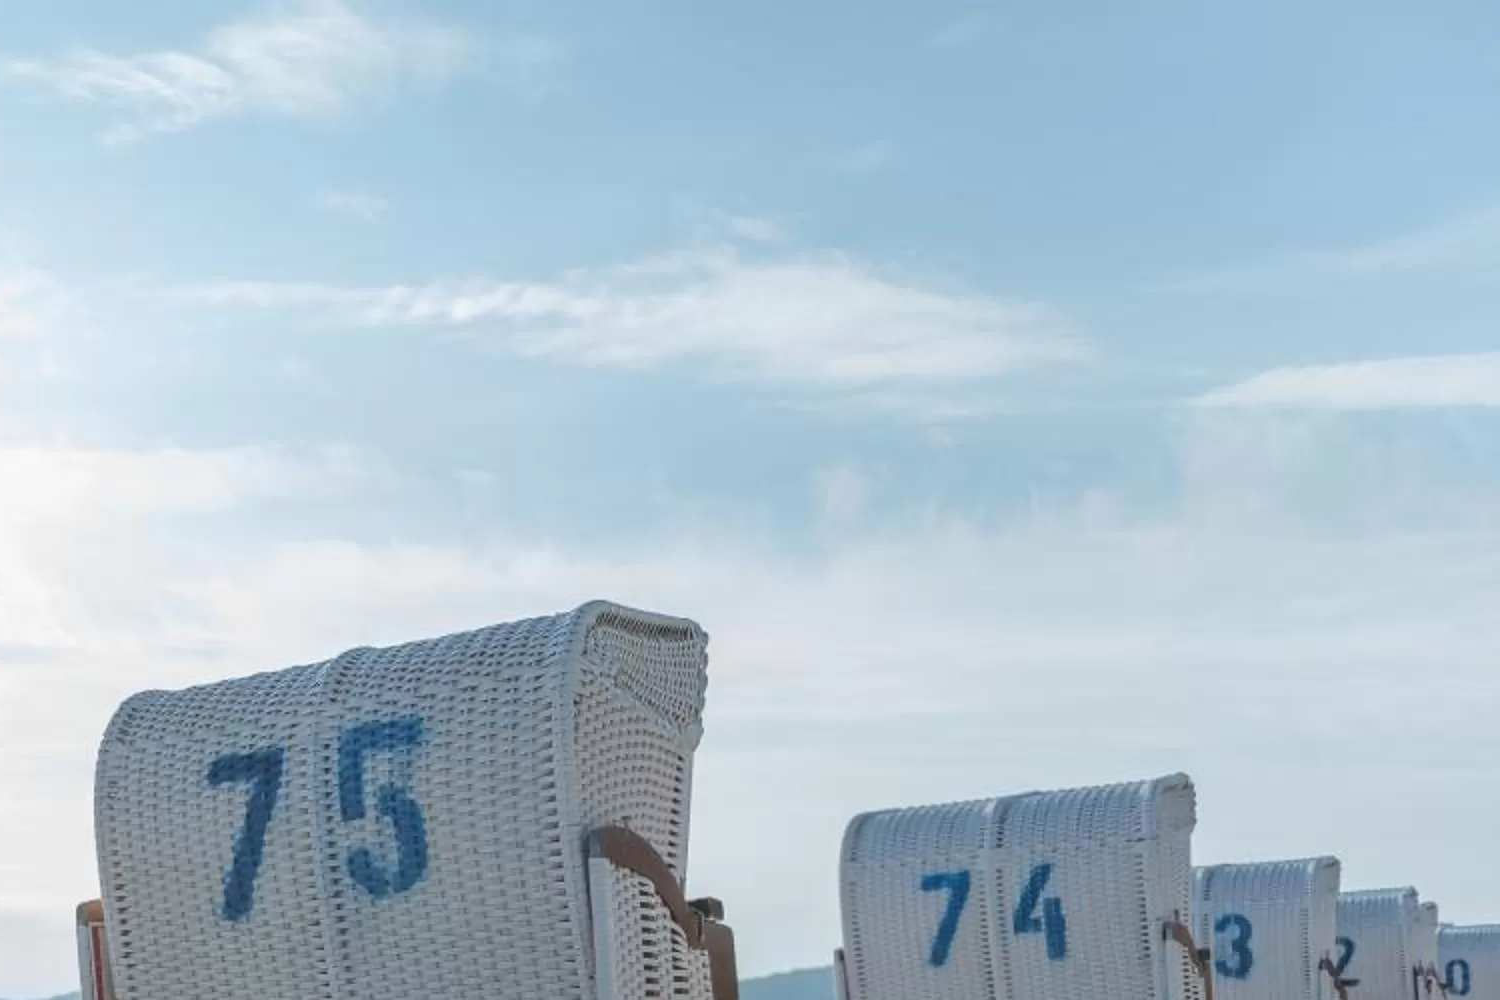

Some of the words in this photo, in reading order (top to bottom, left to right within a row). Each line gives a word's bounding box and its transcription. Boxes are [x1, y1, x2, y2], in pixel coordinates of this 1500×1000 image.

[1214, 913, 1253, 979] 3
[1336, 936, 1360, 988] 2
[1445, 958, 1470, 996] 0
